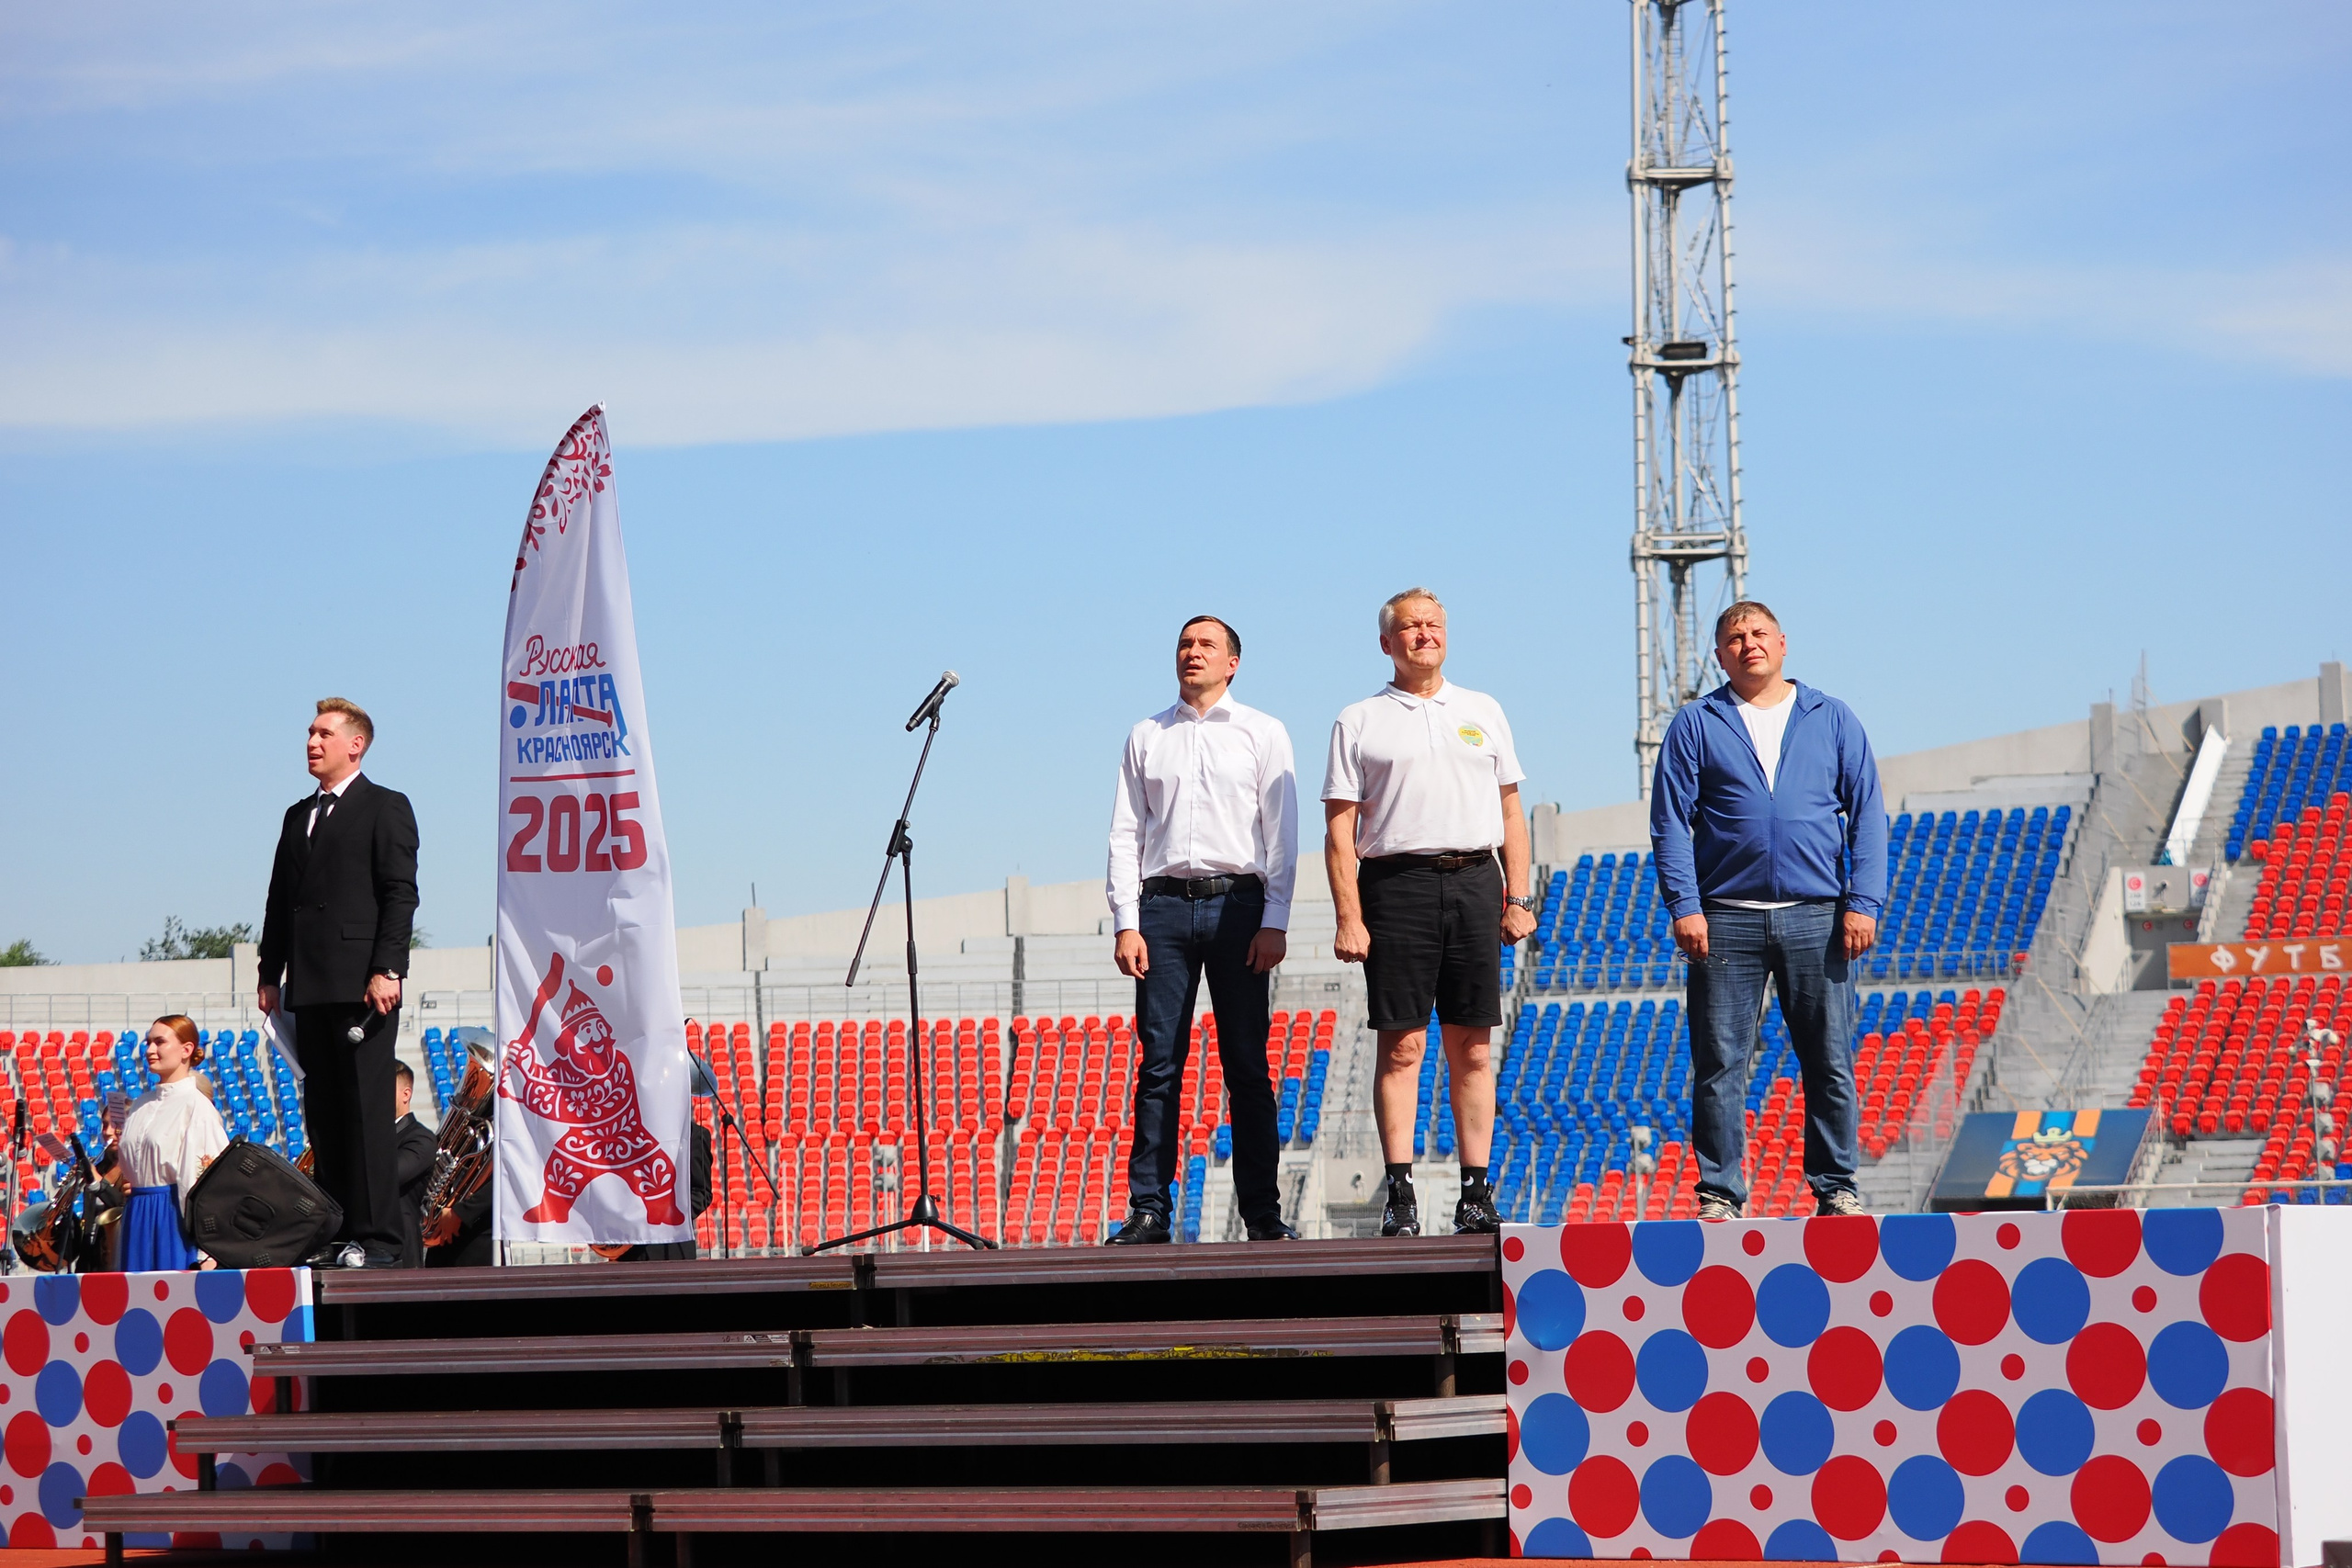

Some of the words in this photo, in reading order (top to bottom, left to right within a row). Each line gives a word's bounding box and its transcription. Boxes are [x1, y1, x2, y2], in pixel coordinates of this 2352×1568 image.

[518, 634, 606, 677] Русская
[517, 731, 632, 764] КРАСНОЯРСК
[506, 791, 648, 873] 2025
[2210, 943, 2343, 975] ФУТБ
